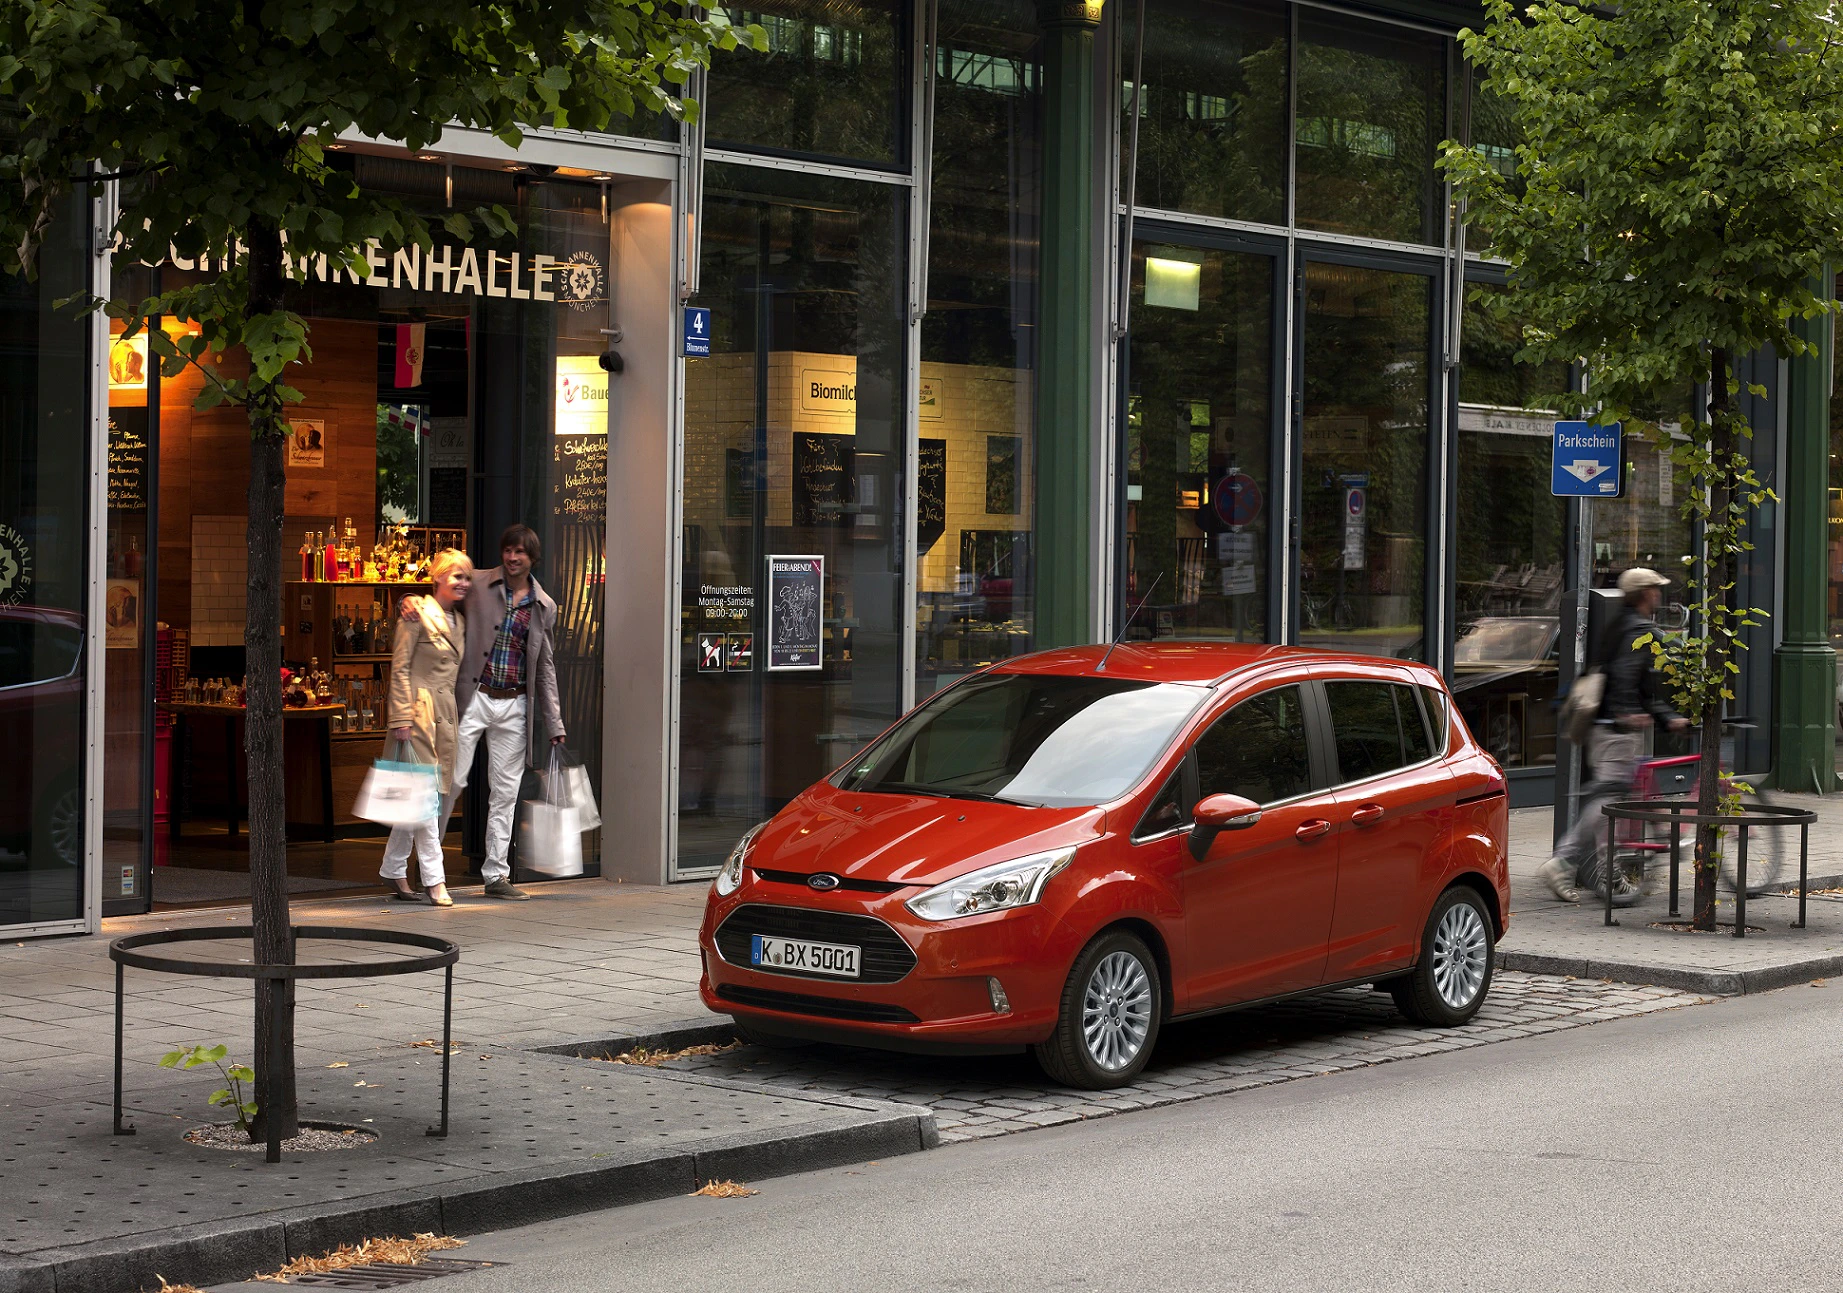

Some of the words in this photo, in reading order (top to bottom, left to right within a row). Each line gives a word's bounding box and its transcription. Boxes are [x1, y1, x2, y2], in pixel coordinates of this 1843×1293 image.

[693, 312, 704, 334] 4
[1558, 433, 1615, 448] Parkschein
[701, 584, 753, 596] Öffnungszeiten:
[698, 597, 754, 607] Montag-Samstag
[705, 608, 748, 618] 09:00-20:00
[762, 940, 772, 962] K
[784, 943, 807, 967] BX
[811, 945, 856, 973] 5001
